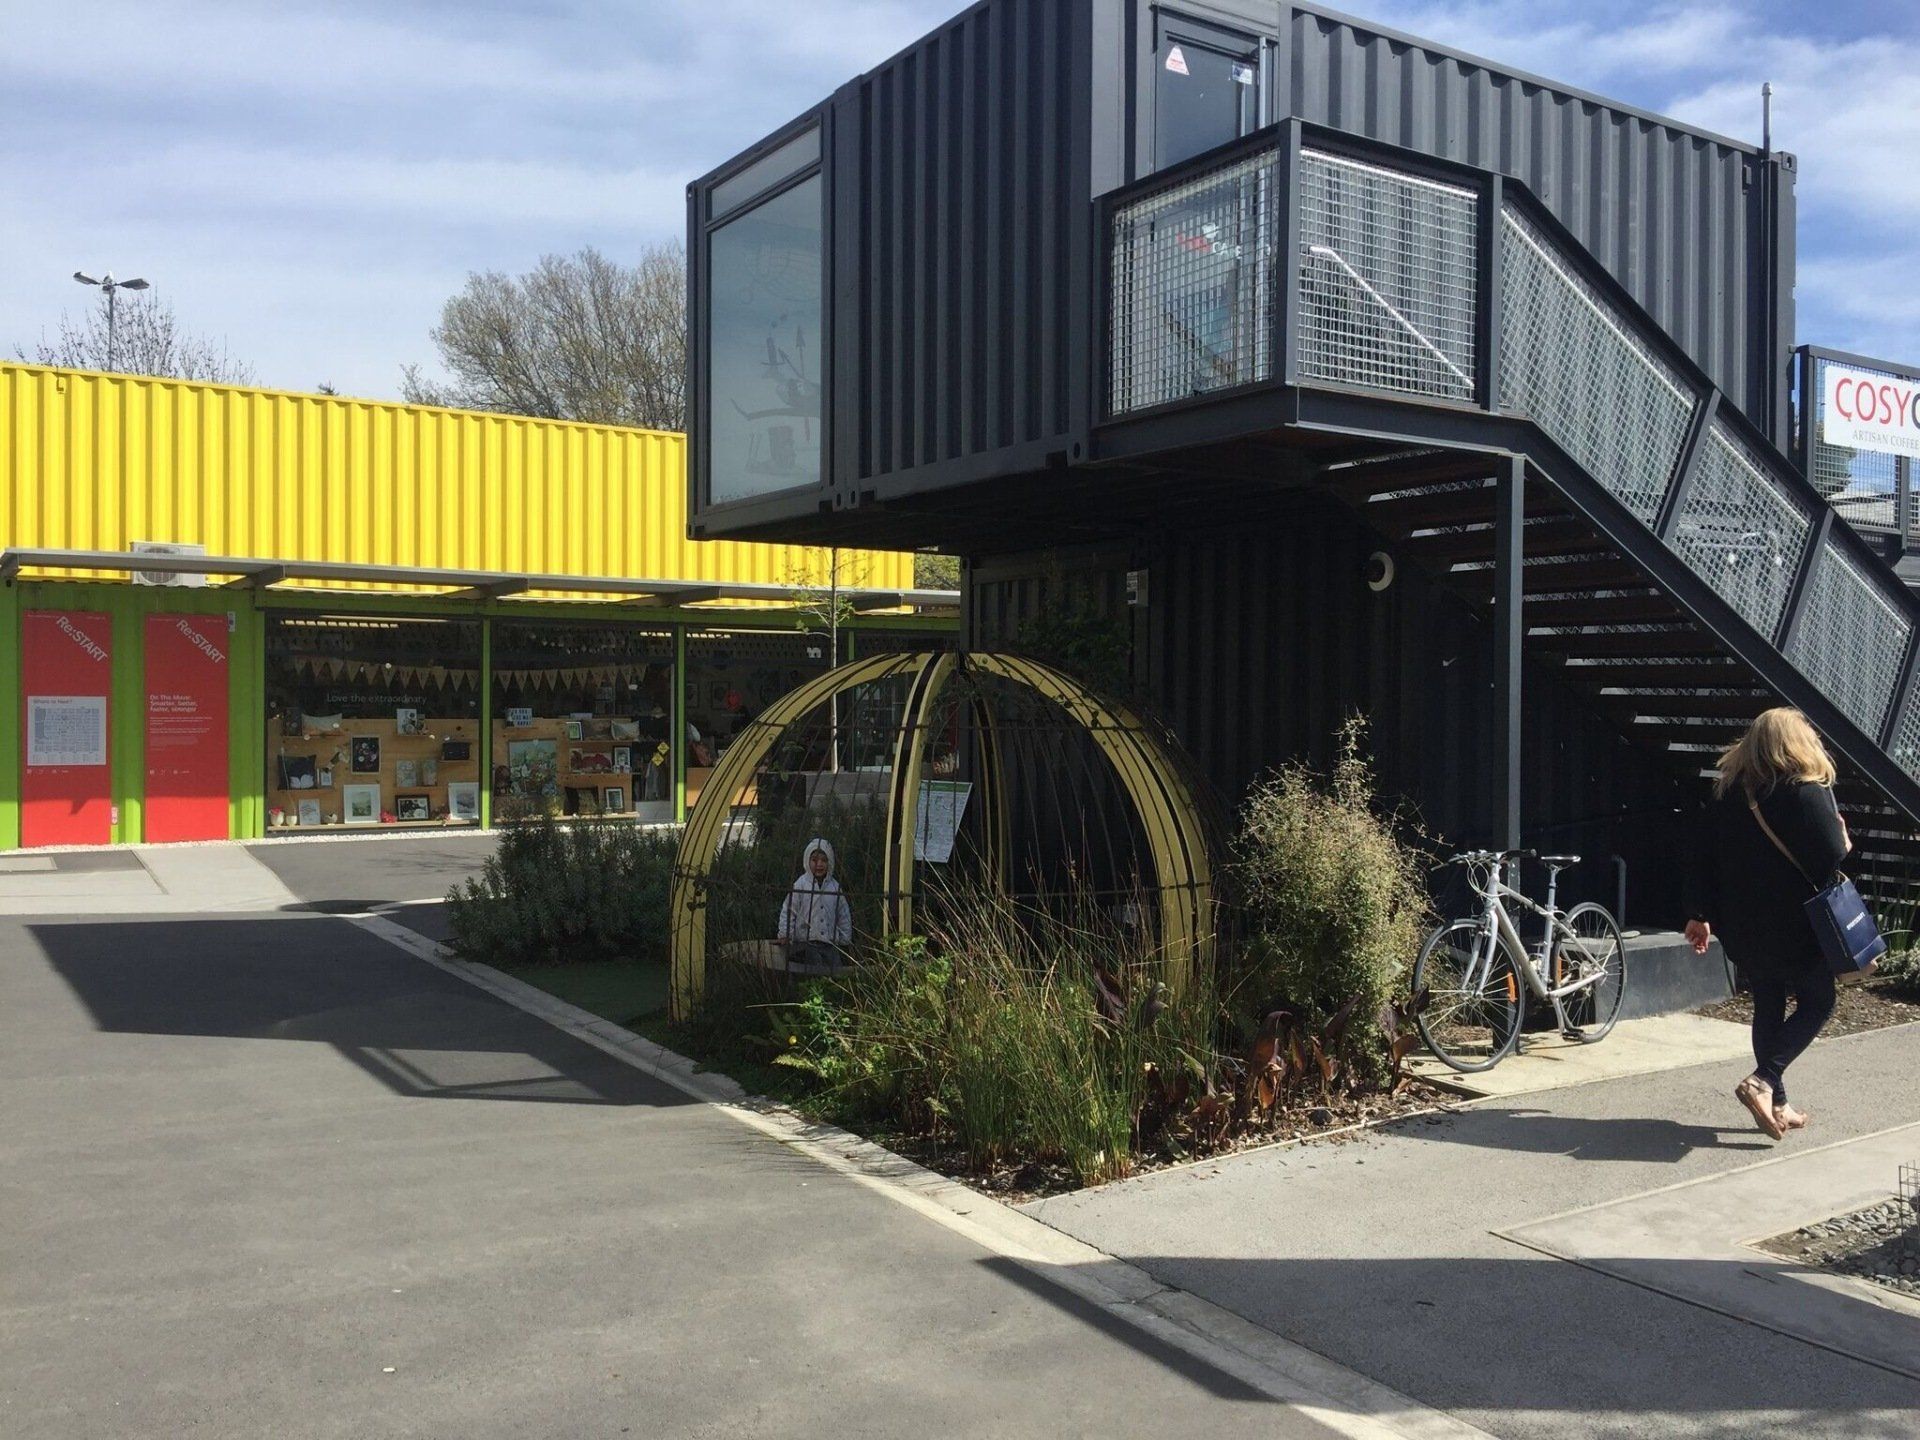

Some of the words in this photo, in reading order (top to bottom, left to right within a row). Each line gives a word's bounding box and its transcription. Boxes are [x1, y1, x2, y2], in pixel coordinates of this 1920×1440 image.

[1853, 430, 1889, 445] ARTISAN
[1890, 435, 1920, 450] COFFEE
[56, 616, 108, 661] Re:START
[176, 619, 226, 663] Re:START
[326, 693, 348, 703] Love
[350, 693, 366, 703] the
[368, 693, 427, 705] extraordinary
